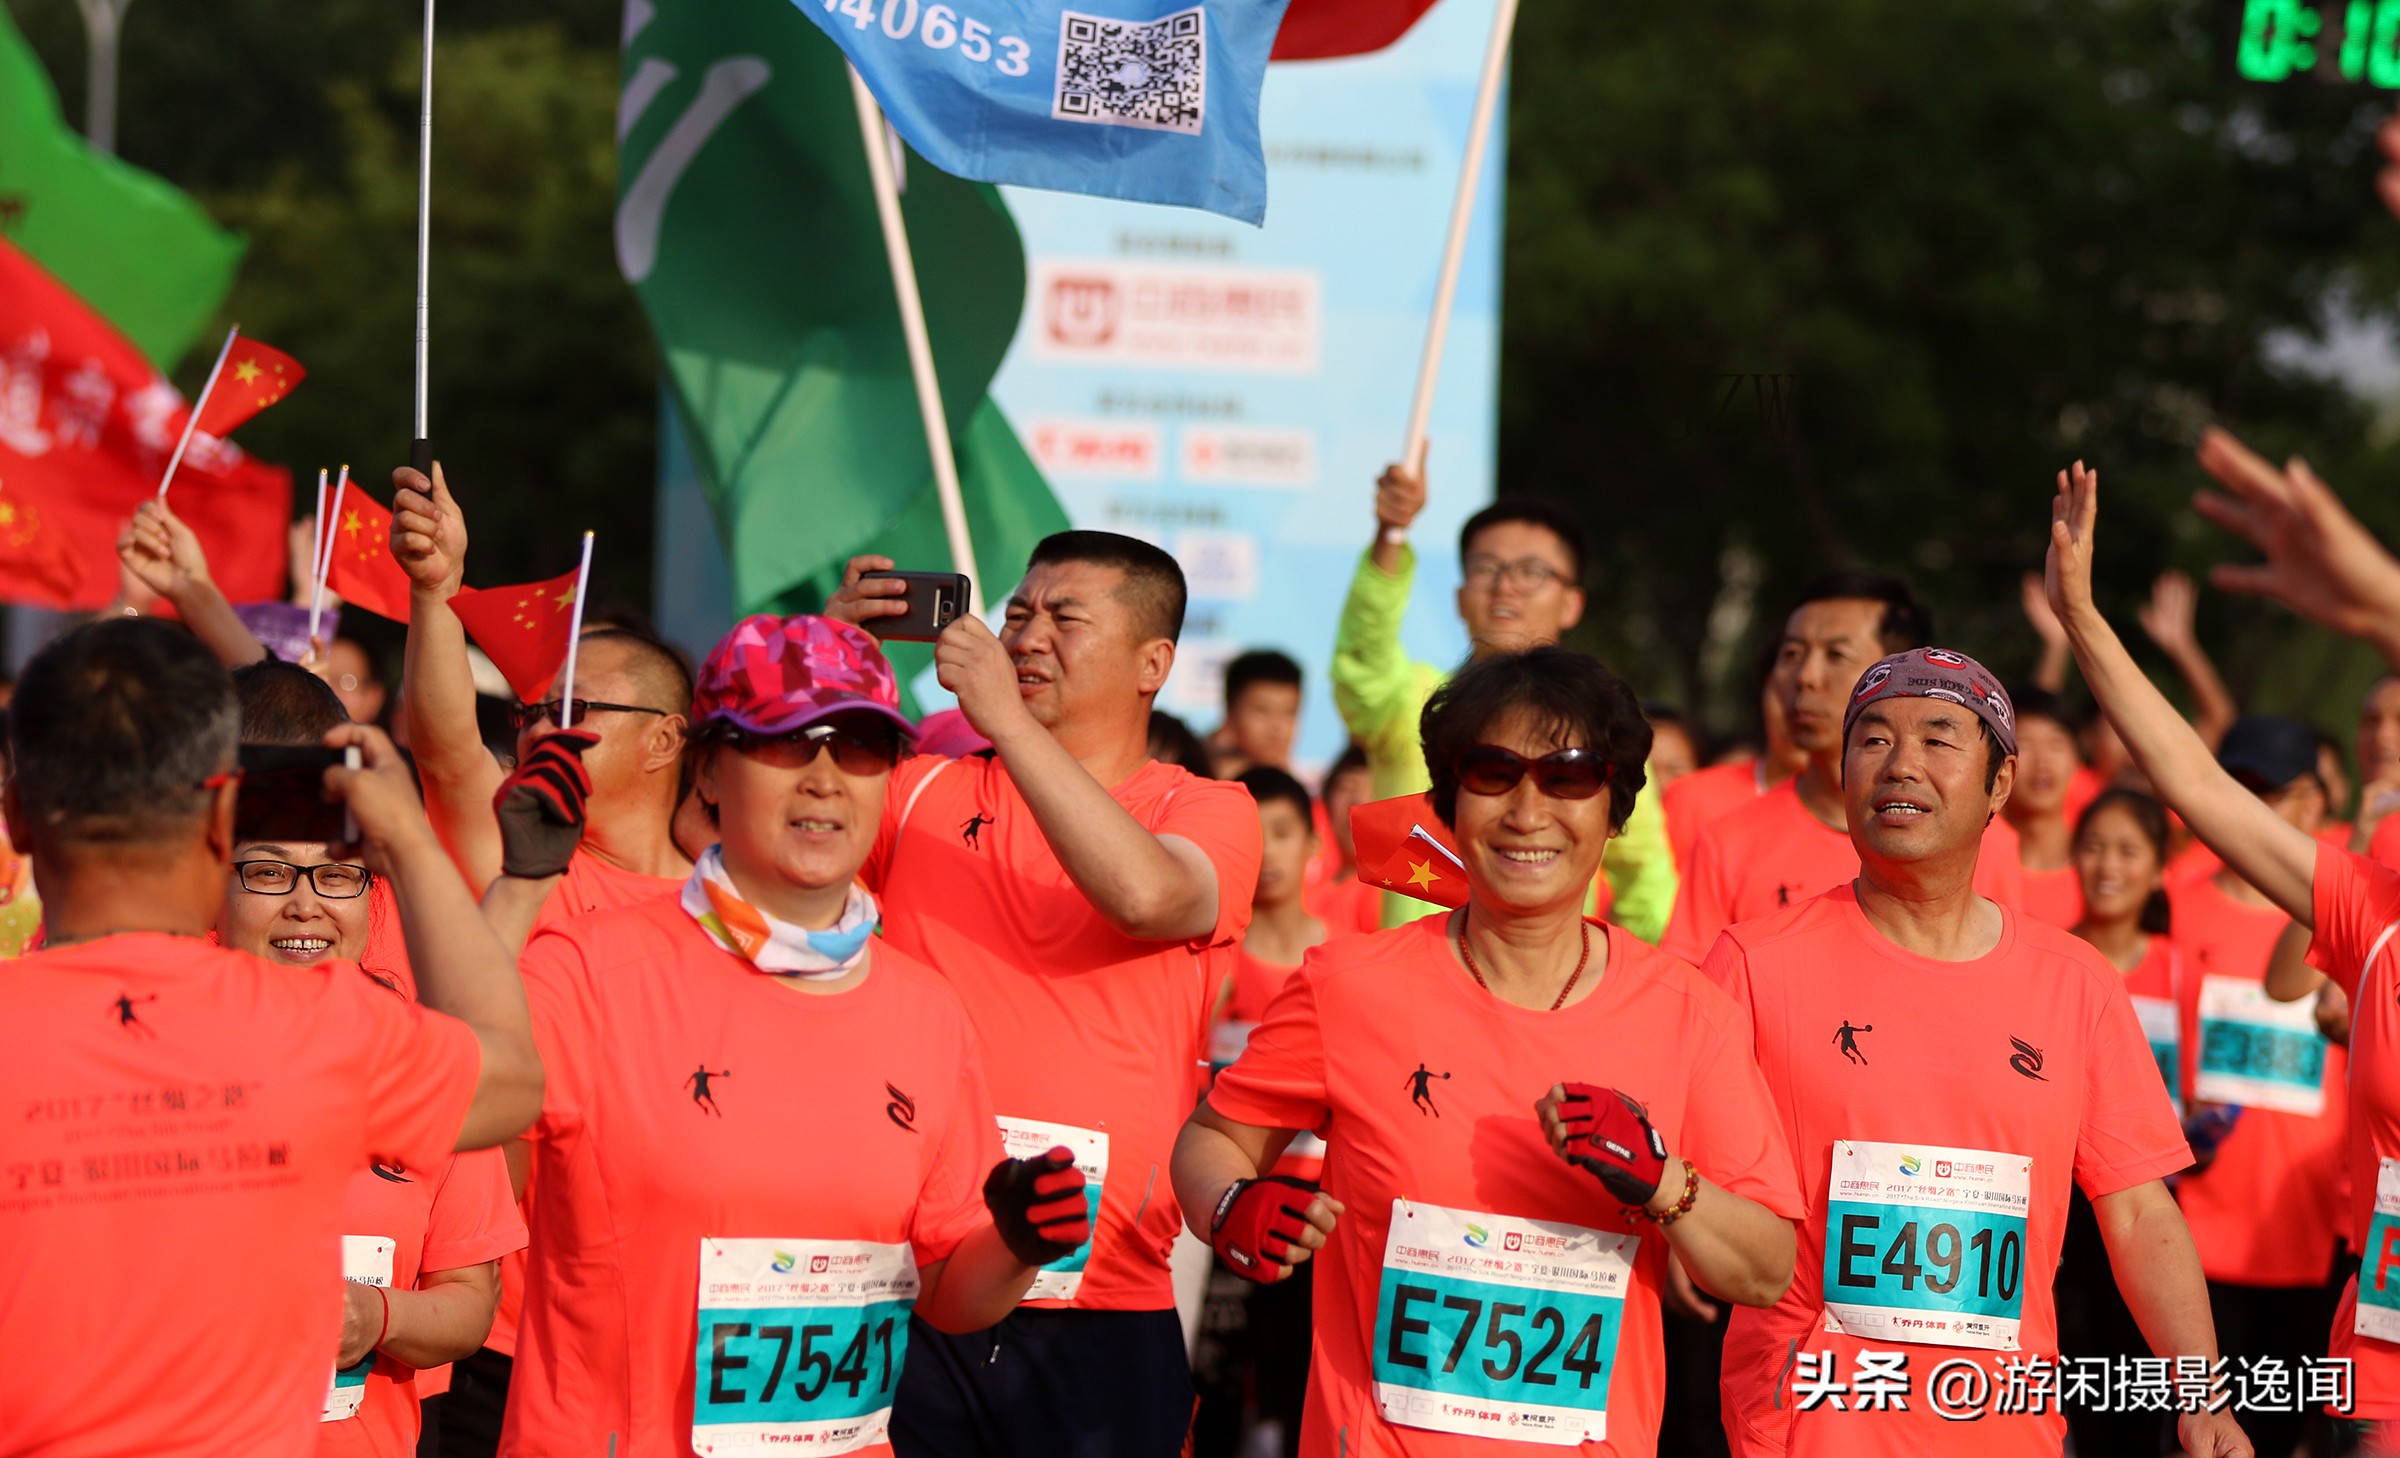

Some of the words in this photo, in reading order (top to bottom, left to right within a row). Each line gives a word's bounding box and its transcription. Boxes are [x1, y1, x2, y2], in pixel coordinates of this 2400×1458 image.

[1954, 1162, 1995, 1175] 中商惠民
[1840, 1180, 1879, 1190] 中商惠民
[1524, 1234, 1567, 1248] 中商惠民
[1396, 1245, 1439, 1261] 中商惠民
[1838, 1214, 2020, 1301] E4910
[1901, 1319, 1946, 1330] 乔丹体育
[1387, 1284, 1602, 1389] E7524
[709, 1317, 894, 1404] E7541
[1452, 1407, 1502, 1422] 乔丹体育
